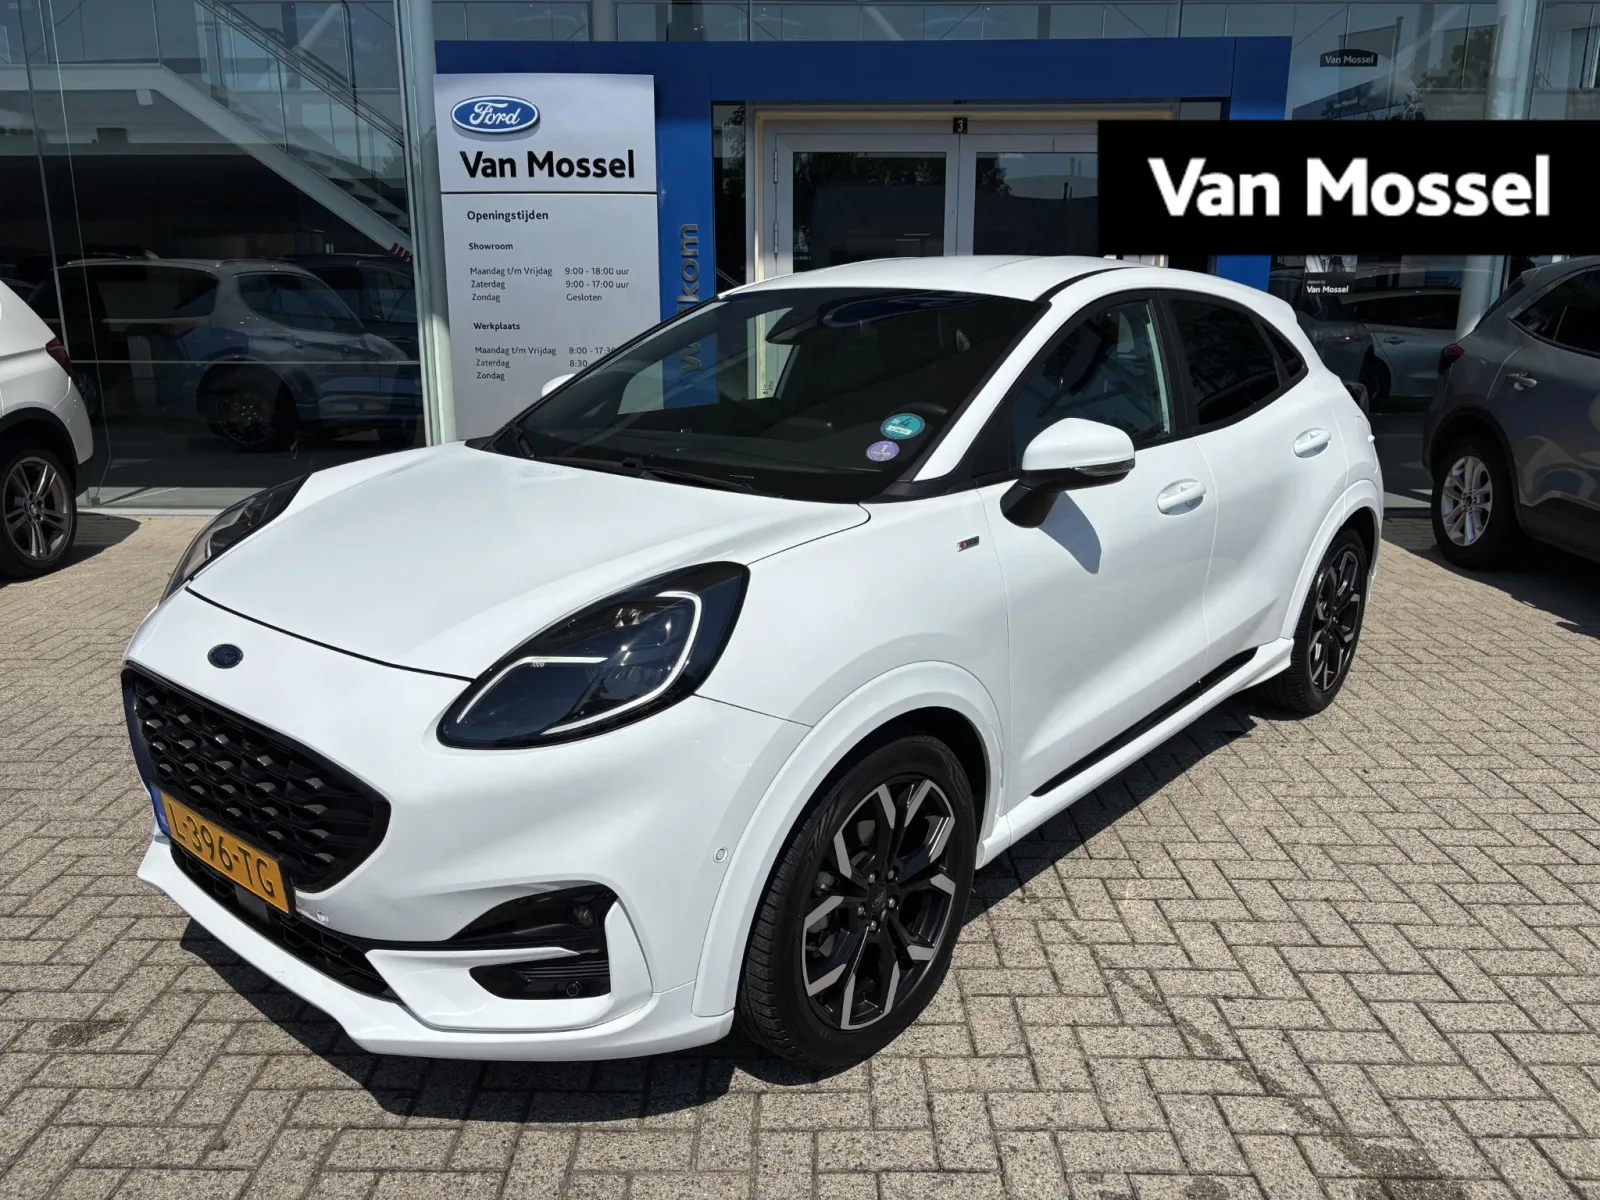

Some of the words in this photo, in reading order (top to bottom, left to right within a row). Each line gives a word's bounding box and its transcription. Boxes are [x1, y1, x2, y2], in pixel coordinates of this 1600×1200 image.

[1325, 55, 1341, 64] Van
[1343, 54, 1374, 64] Mossel
[469, 102, 521, 125] Ford
[957, 119, 964, 132] 3
[459, 150, 516, 178] Van
[527, 149, 635, 178] Mossel
[467, 210, 549, 223] Openingstijden
[468, 242, 514, 251] Showroom
[470, 267, 506, 277] Maandag
[507, 267, 522, 276] t/m
[524, 267, 553, 277] Vrijdag
[565, 267, 584, 275] 9:00
[591, 267, 614, 275] 18:00
[471, 280, 506, 290] Zaterdag
[565, 280, 585, 289] 9:00
[592, 280, 614, 289] 17:00
[1322, 285, 1349, 293] Mossel
[472, 293, 501, 303] Zondag
[566, 293, 602, 301] Gesloten
[473, 322, 520, 331] Werkplaats
[475, 346, 510, 356] Maandag
[511, 346, 526, 355] t/m
[528, 346, 556, 356] Vrijdag
[569, 346, 588, 355] 8:00
[476, 359, 510, 368] Zaterdag
[569, 360, 588, 368] 8:30
[477, 372, 505, 381] Zondag
[168, 802, 276, 897] L-396-TG
